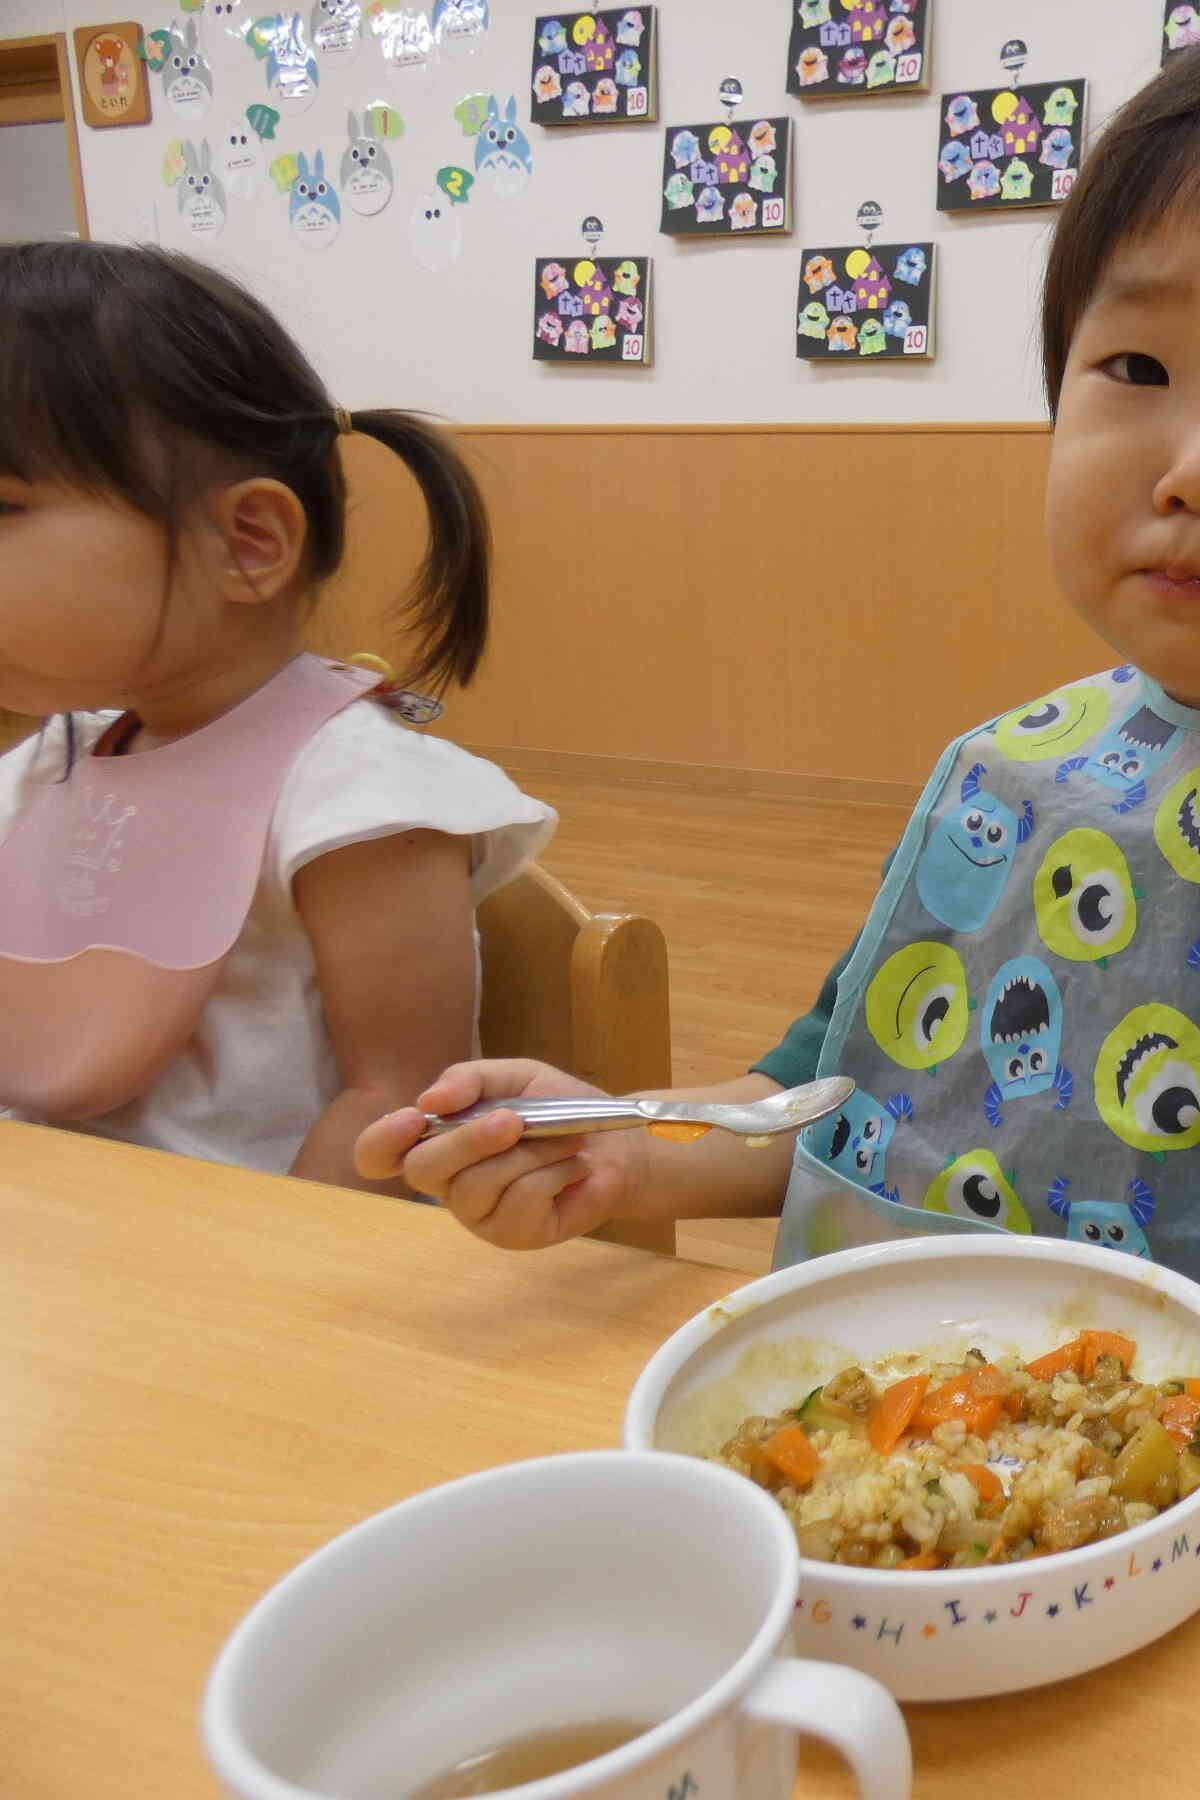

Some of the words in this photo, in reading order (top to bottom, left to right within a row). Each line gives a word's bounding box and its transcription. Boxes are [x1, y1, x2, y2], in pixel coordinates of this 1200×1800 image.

[898, 59, 917, 77] 10
[101, 96, 128, 109] といれ
[629, 92, 645, 110] 10
[447, 171, 463, 196] 2
[1055, 174, 1073, 194] 10
[764, 203, 781, 221] 10
[624, 339, 641, 356] 10
[906, 330, 924, 348] 10
[876, 1617, 904, 1645] H
[944, 1599, 967, 1625] I
[1010, 1592, 1032, 1617] J
[1074, 1582, 1093, 1610] K
[1128, 1552, 1142, 1577] L
[1171, 1533, 1189, 1562] M
